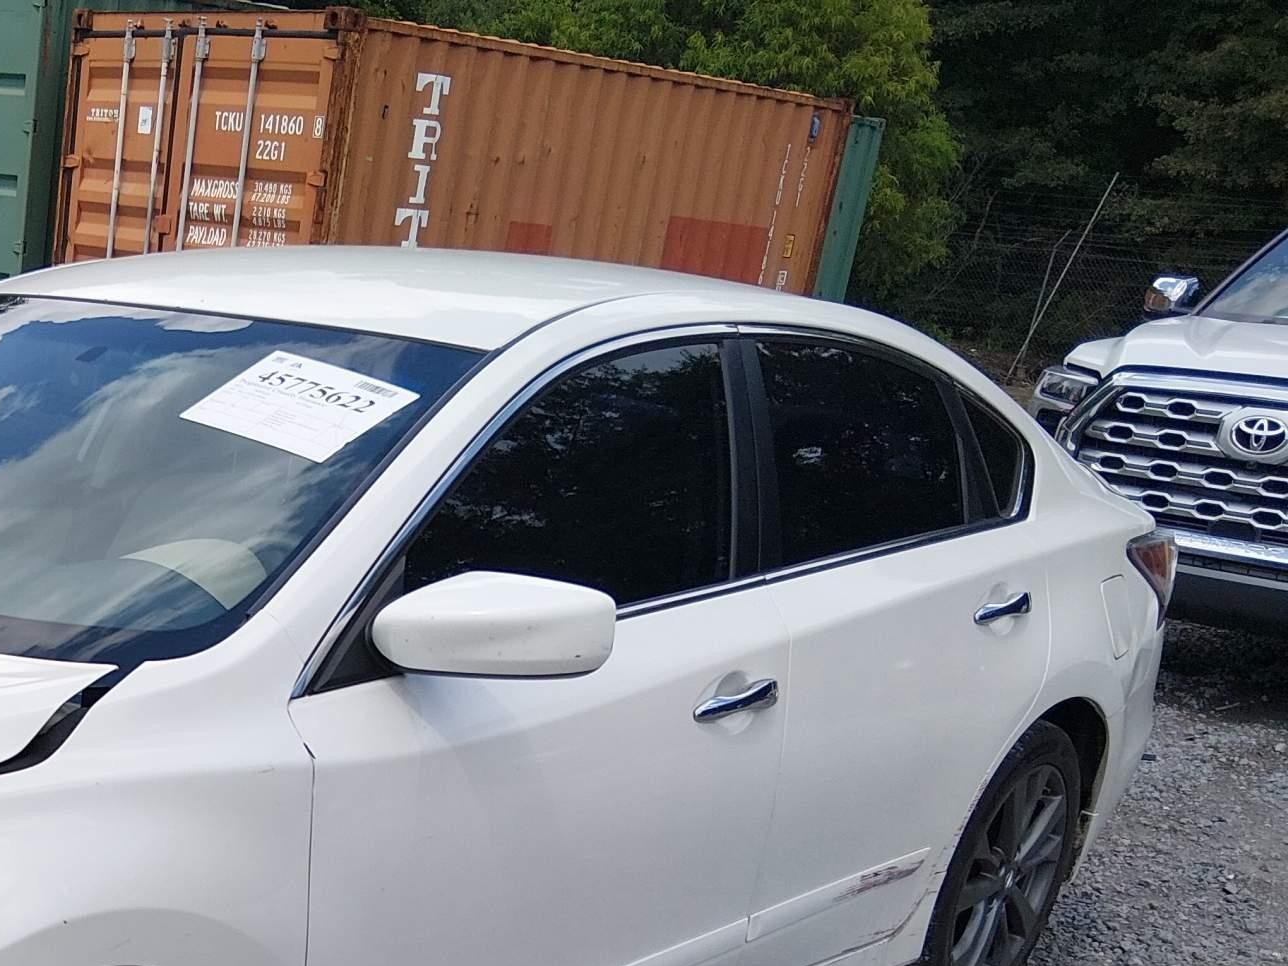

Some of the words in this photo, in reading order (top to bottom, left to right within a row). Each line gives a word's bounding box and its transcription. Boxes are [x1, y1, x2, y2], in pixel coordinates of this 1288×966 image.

[215, 111, 244, 132] TCKU
[260, 114, 304, 136] 141860
[255, 140, 285, 161] 22G1
[191, 178, 239, 200] MAXGROSS
[189, 202, 210, 221] TARE
[213, 204, 228, 224] WT.
[186, 226, 227, 246] PAYLOAD
[258, 370, 376, 413] 45775622
